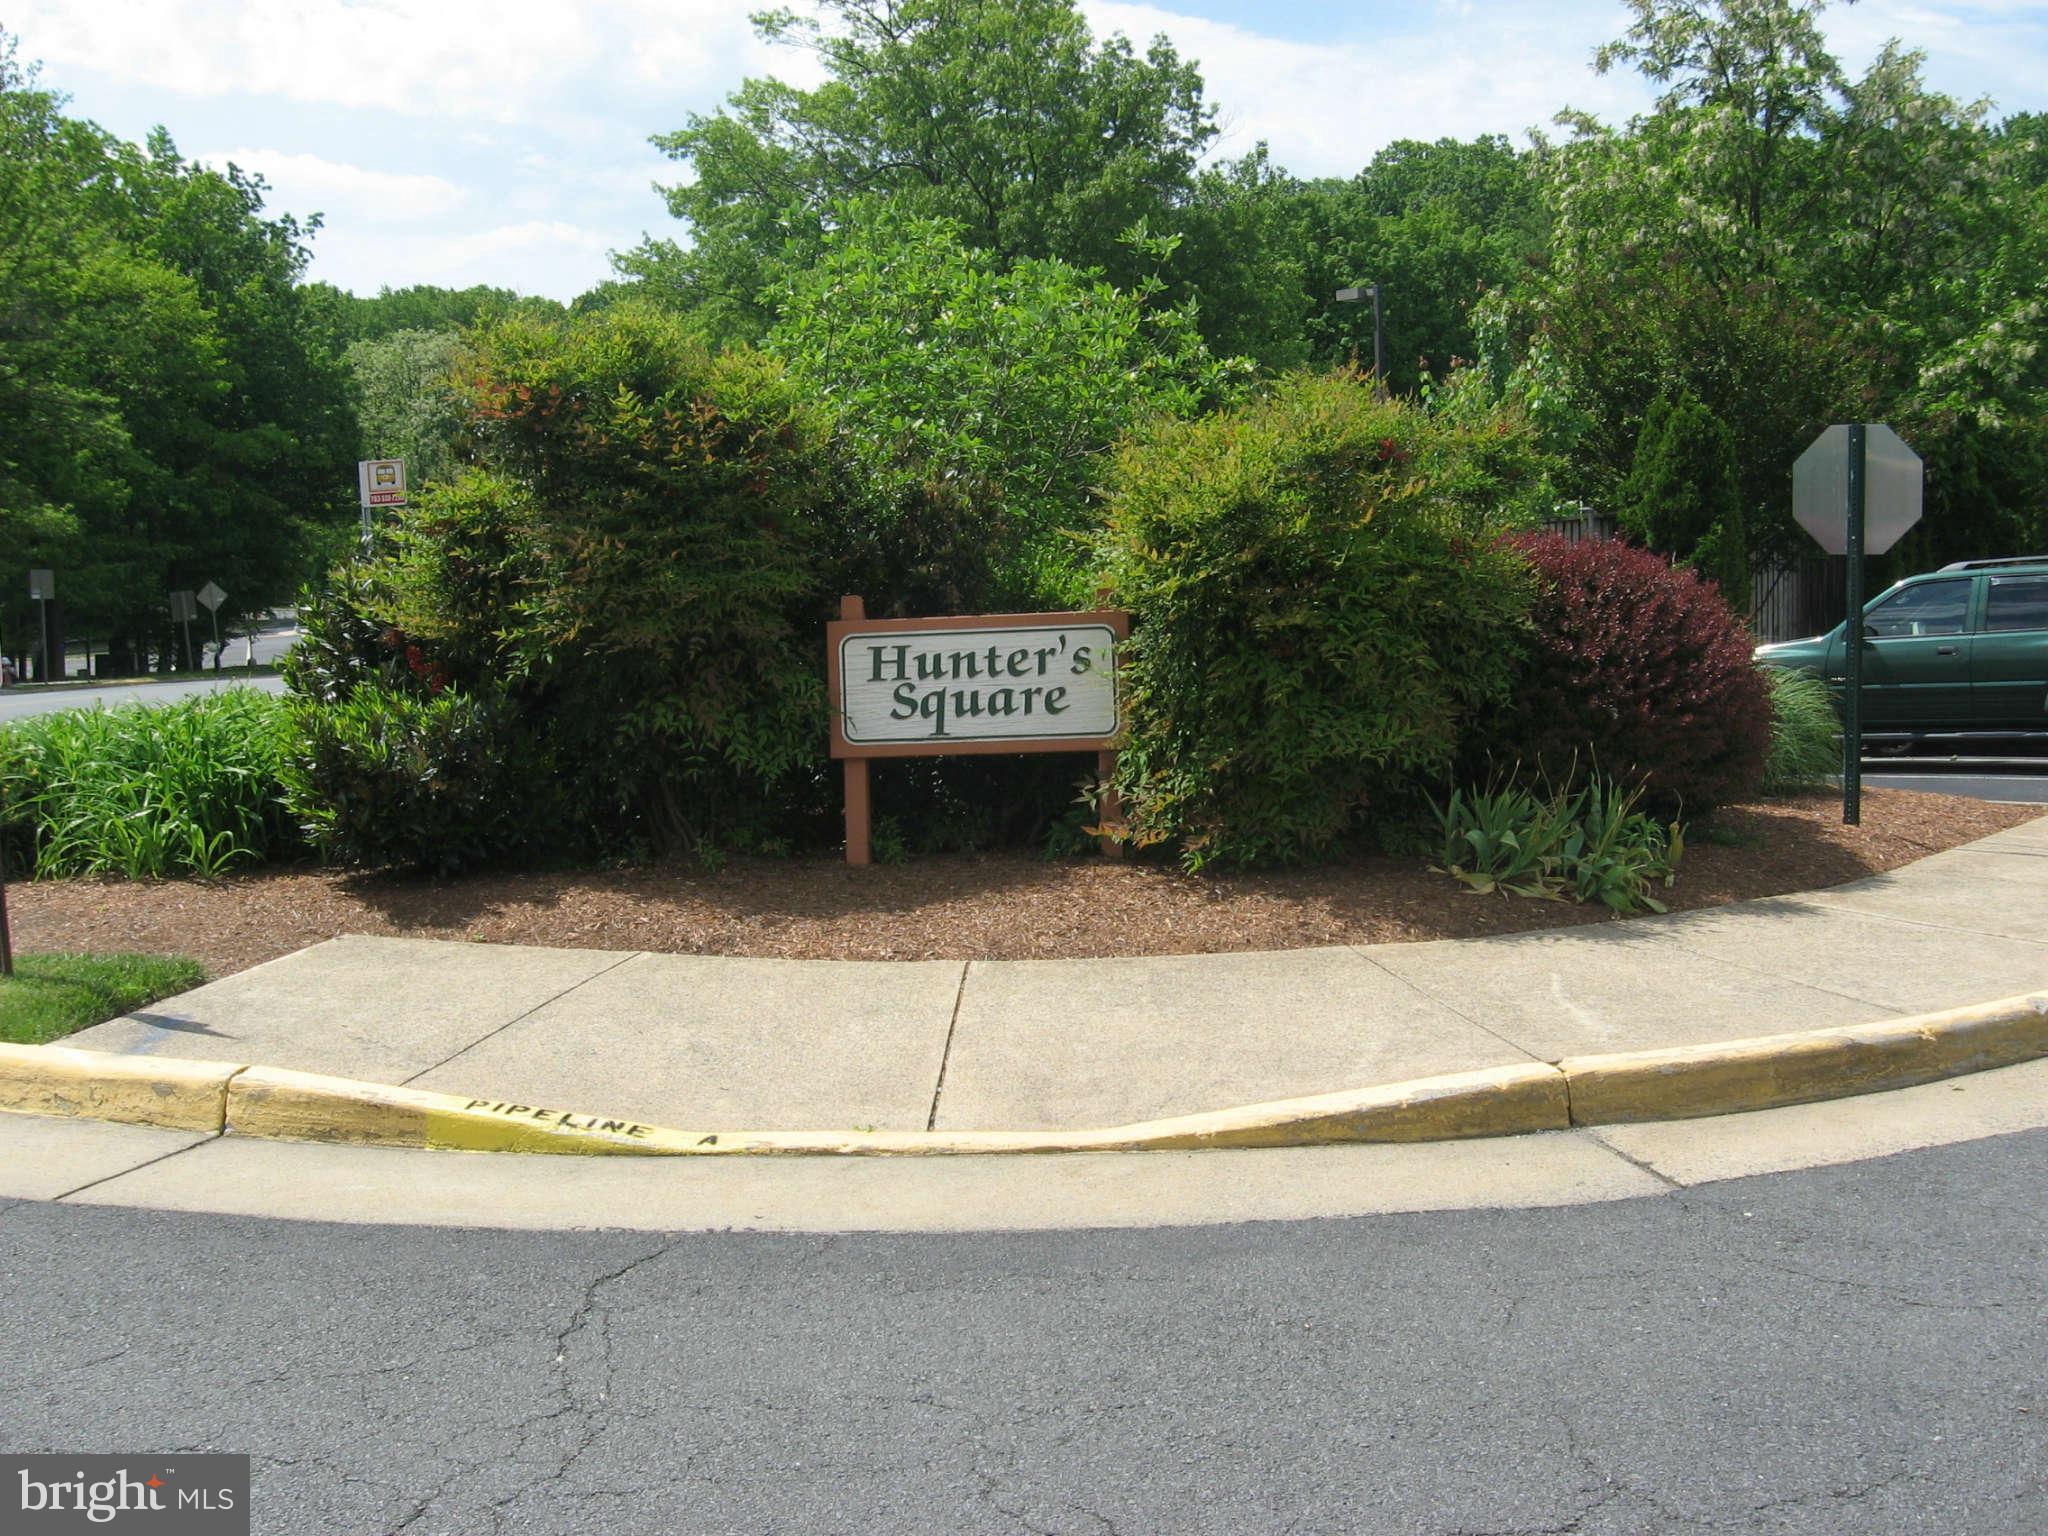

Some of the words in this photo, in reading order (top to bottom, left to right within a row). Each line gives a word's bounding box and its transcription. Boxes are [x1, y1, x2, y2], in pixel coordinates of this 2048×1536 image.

[867, 635, 1092, 682] Hunter's
[890, 682, 1070, 736] Square
[465, 1100, 654, 1138] PIPELINE
